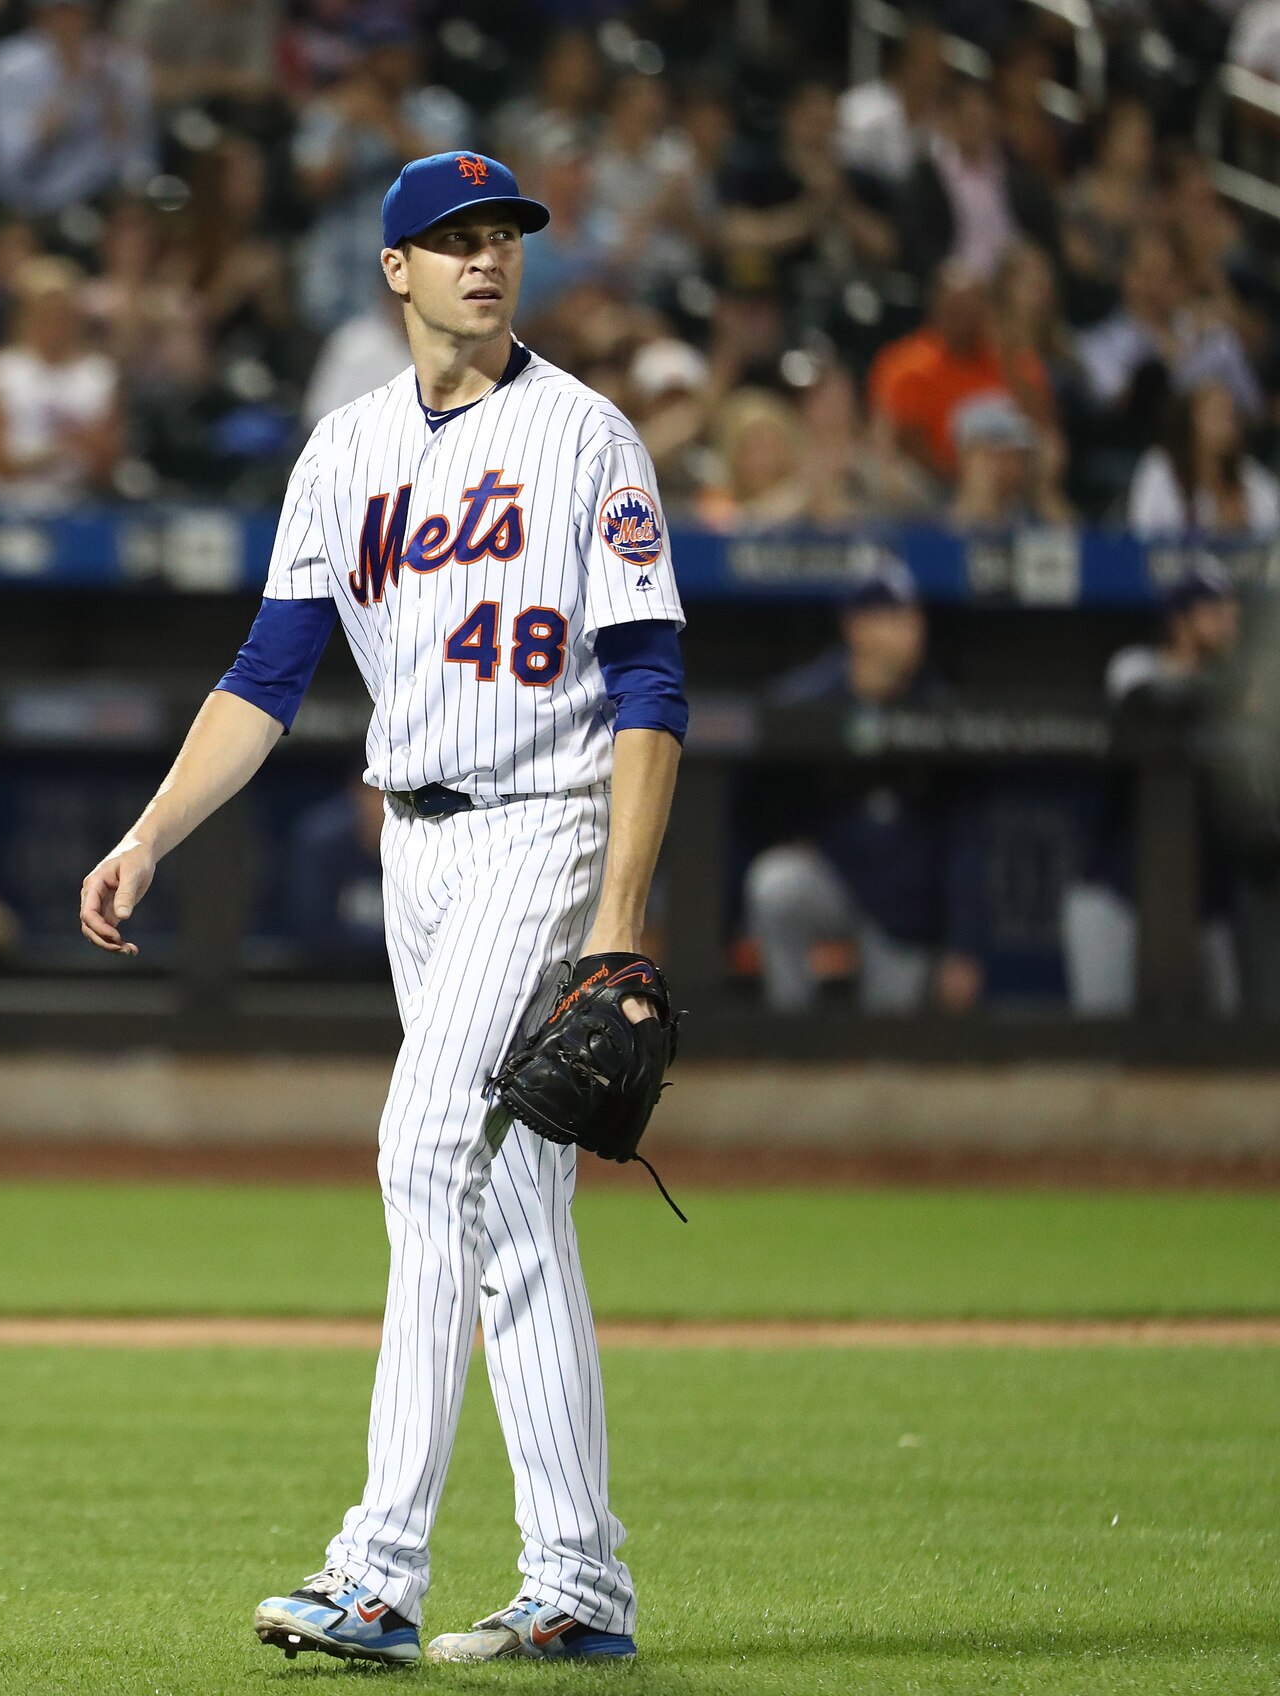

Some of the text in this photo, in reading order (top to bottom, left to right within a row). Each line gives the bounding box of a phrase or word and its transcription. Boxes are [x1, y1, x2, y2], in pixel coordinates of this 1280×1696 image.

[455, 156, 489, 186] NY
[349, 469, 524, 607] Mets
[613, 517, 654, 544] Mets
[445, 600, 568, 687] 48
